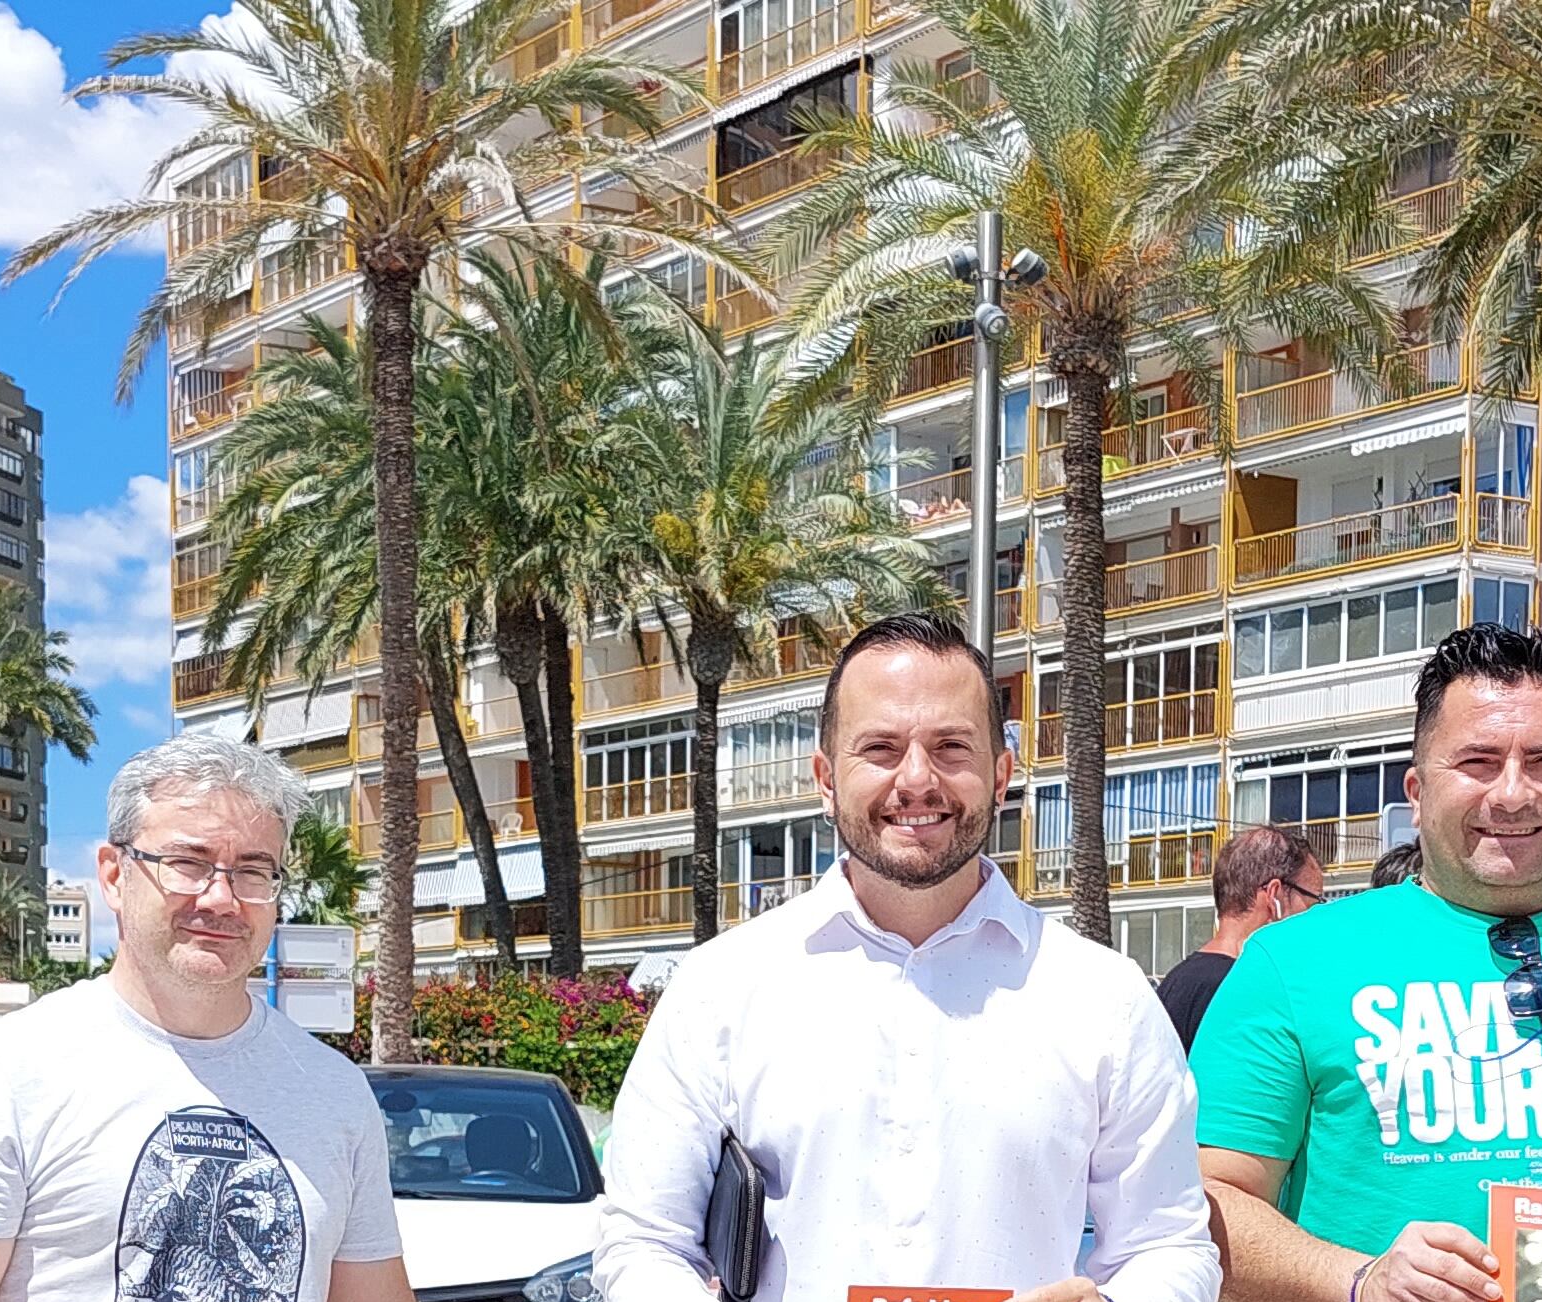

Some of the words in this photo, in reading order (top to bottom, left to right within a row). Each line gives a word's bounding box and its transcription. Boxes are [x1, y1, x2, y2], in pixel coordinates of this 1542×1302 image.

[170, 1120, 206, 1134] PEARL
[206, 1122, 224, 1136] OF
[1383, 1152, 1430, 1164] Heaven
[1434, 1152, 1444, 1162] is
[1449, 1147, 1492, 1162] under
